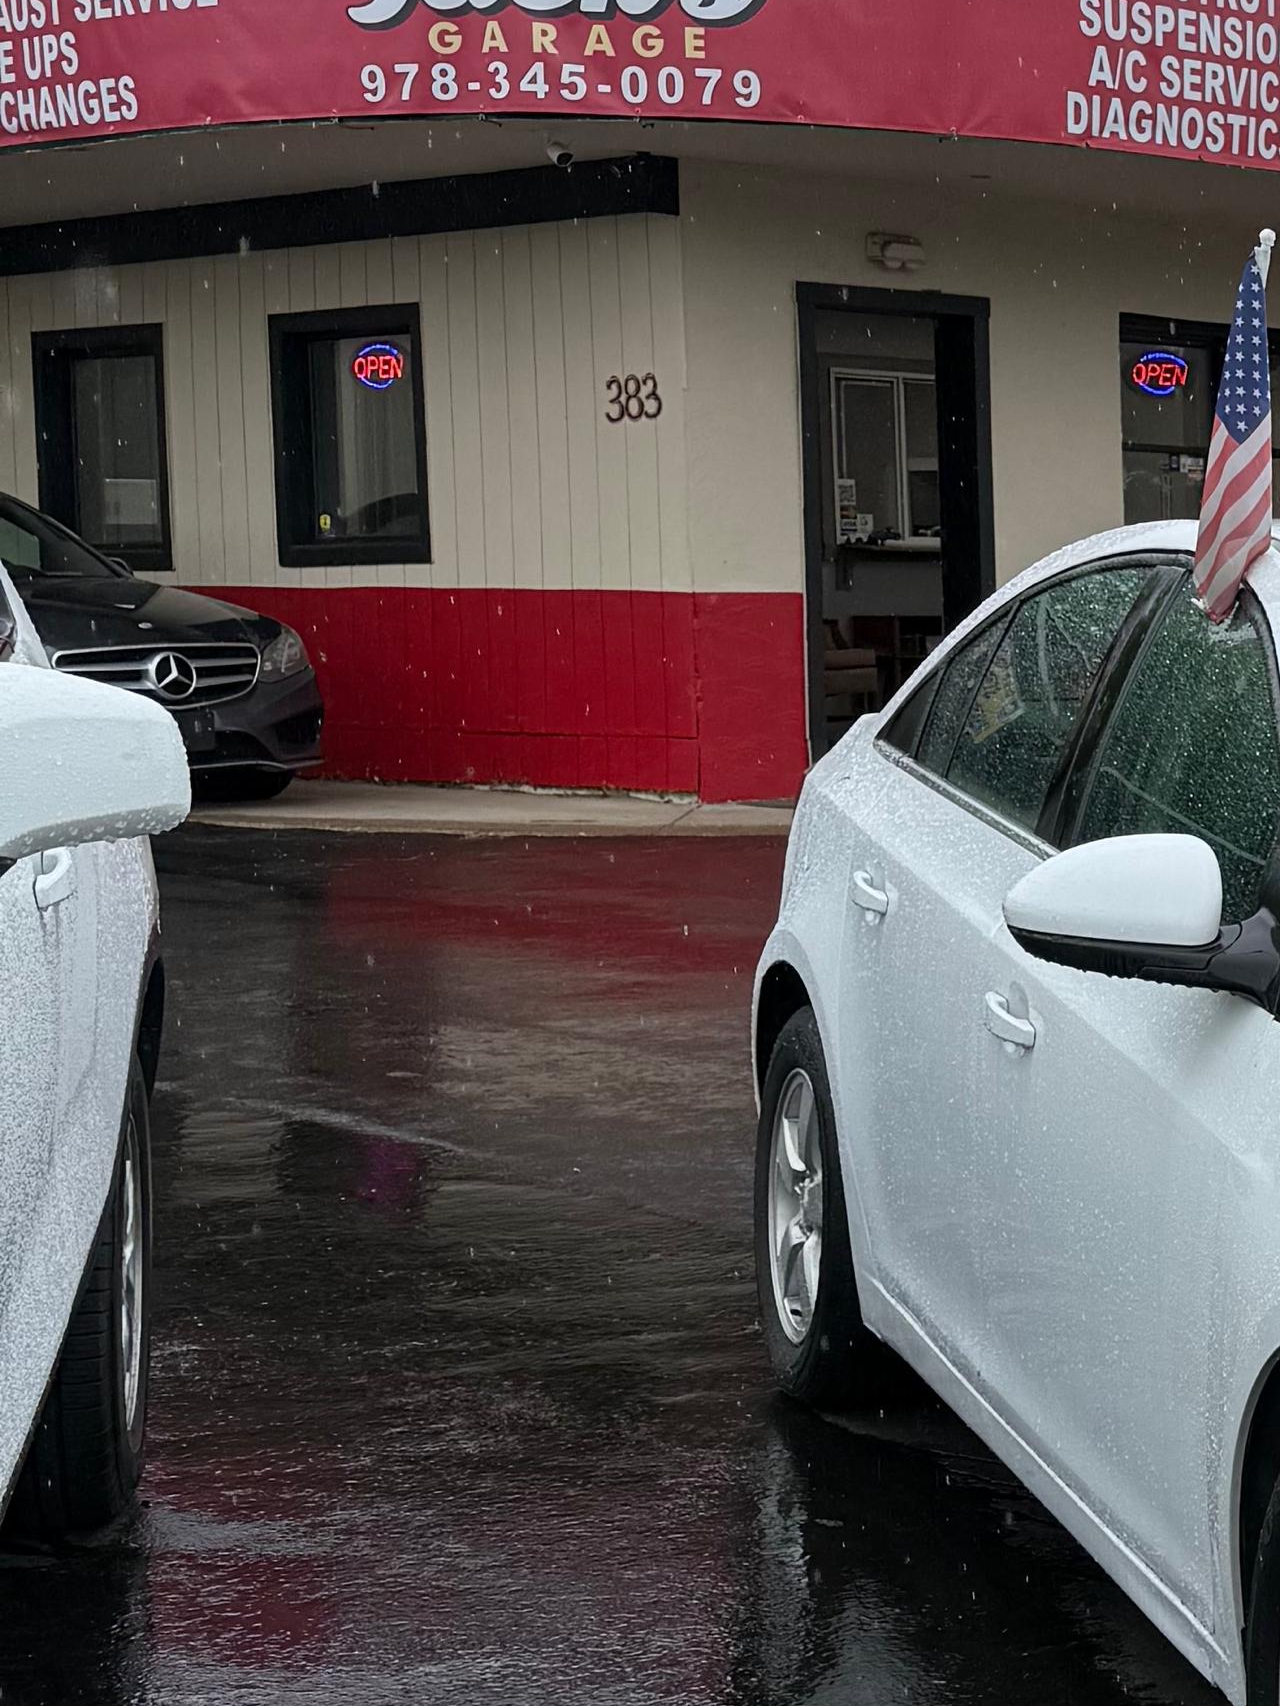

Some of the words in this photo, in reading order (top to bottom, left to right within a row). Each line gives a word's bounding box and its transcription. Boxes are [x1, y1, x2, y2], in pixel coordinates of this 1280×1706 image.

[22, 31, 79, 80] UPS
[428, 23, 707, 60] GARAGE
[360, 61, 763, 108] 978-345-0079
[1088, 45, 1148, 94] A/C
[0, 75, 138, 134] CHANGES
[354, 353, 403, 380] OPEN
[1132, 363, 1189, 387] OPEN
[605, 371, 663, 423] 383
